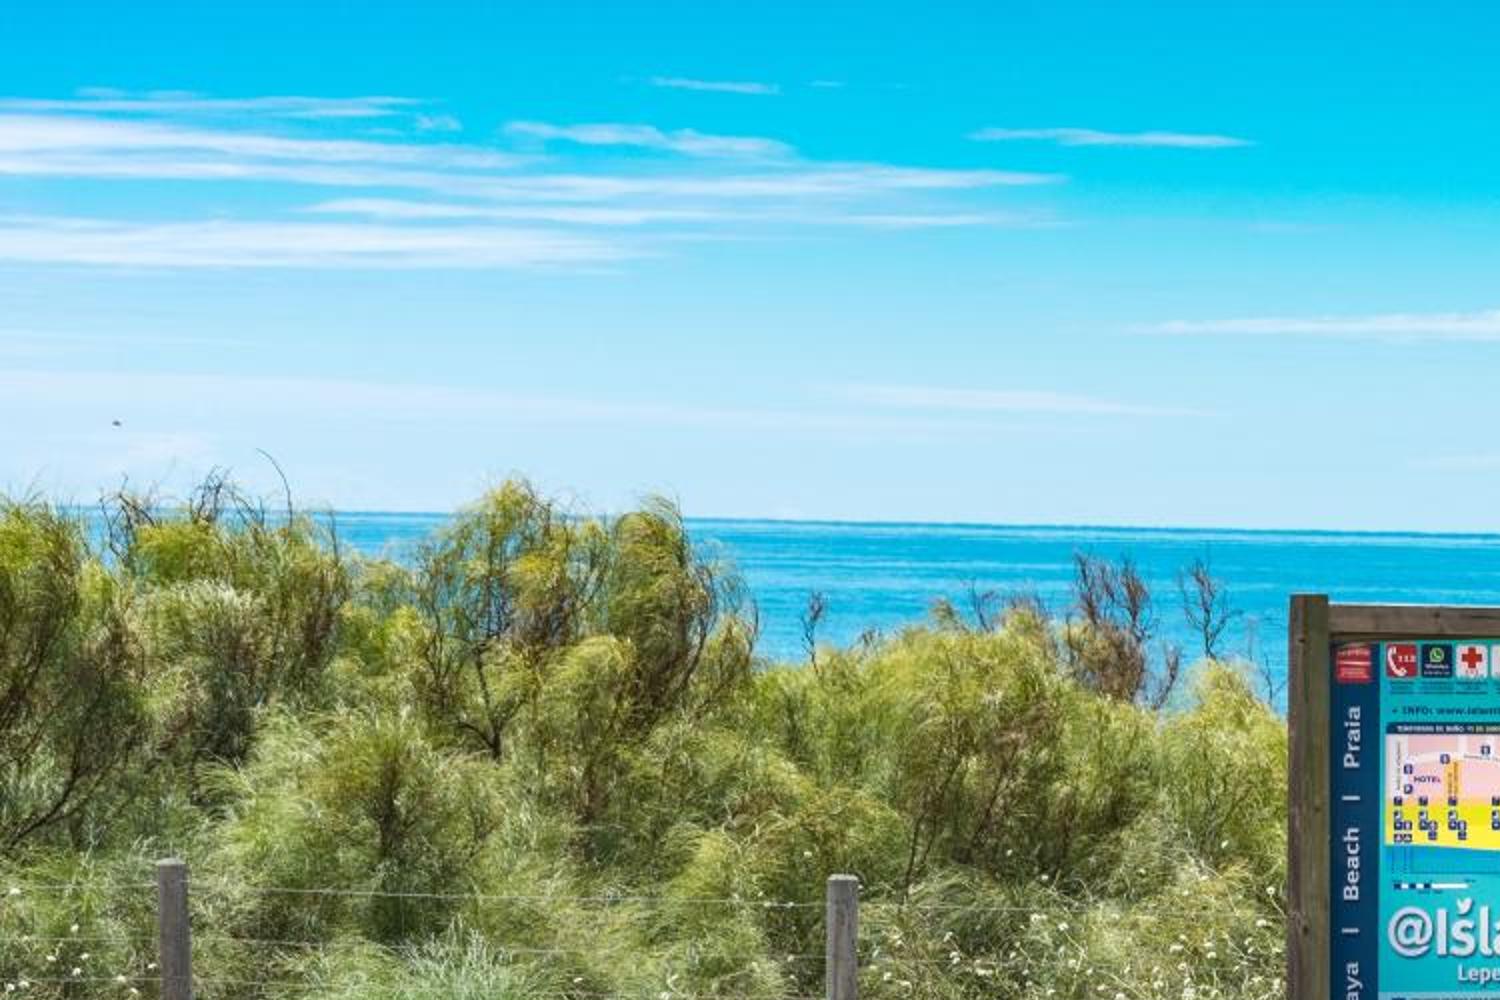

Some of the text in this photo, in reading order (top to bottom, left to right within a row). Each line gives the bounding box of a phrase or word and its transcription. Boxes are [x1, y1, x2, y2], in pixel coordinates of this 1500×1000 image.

[1403, 706, 1433, 715] INFO:
[1343, 705, 1361, 768] Praia
[1413, 775, 1441, 783] HOTEL
[1343, 827, 1360, 900] Beach
